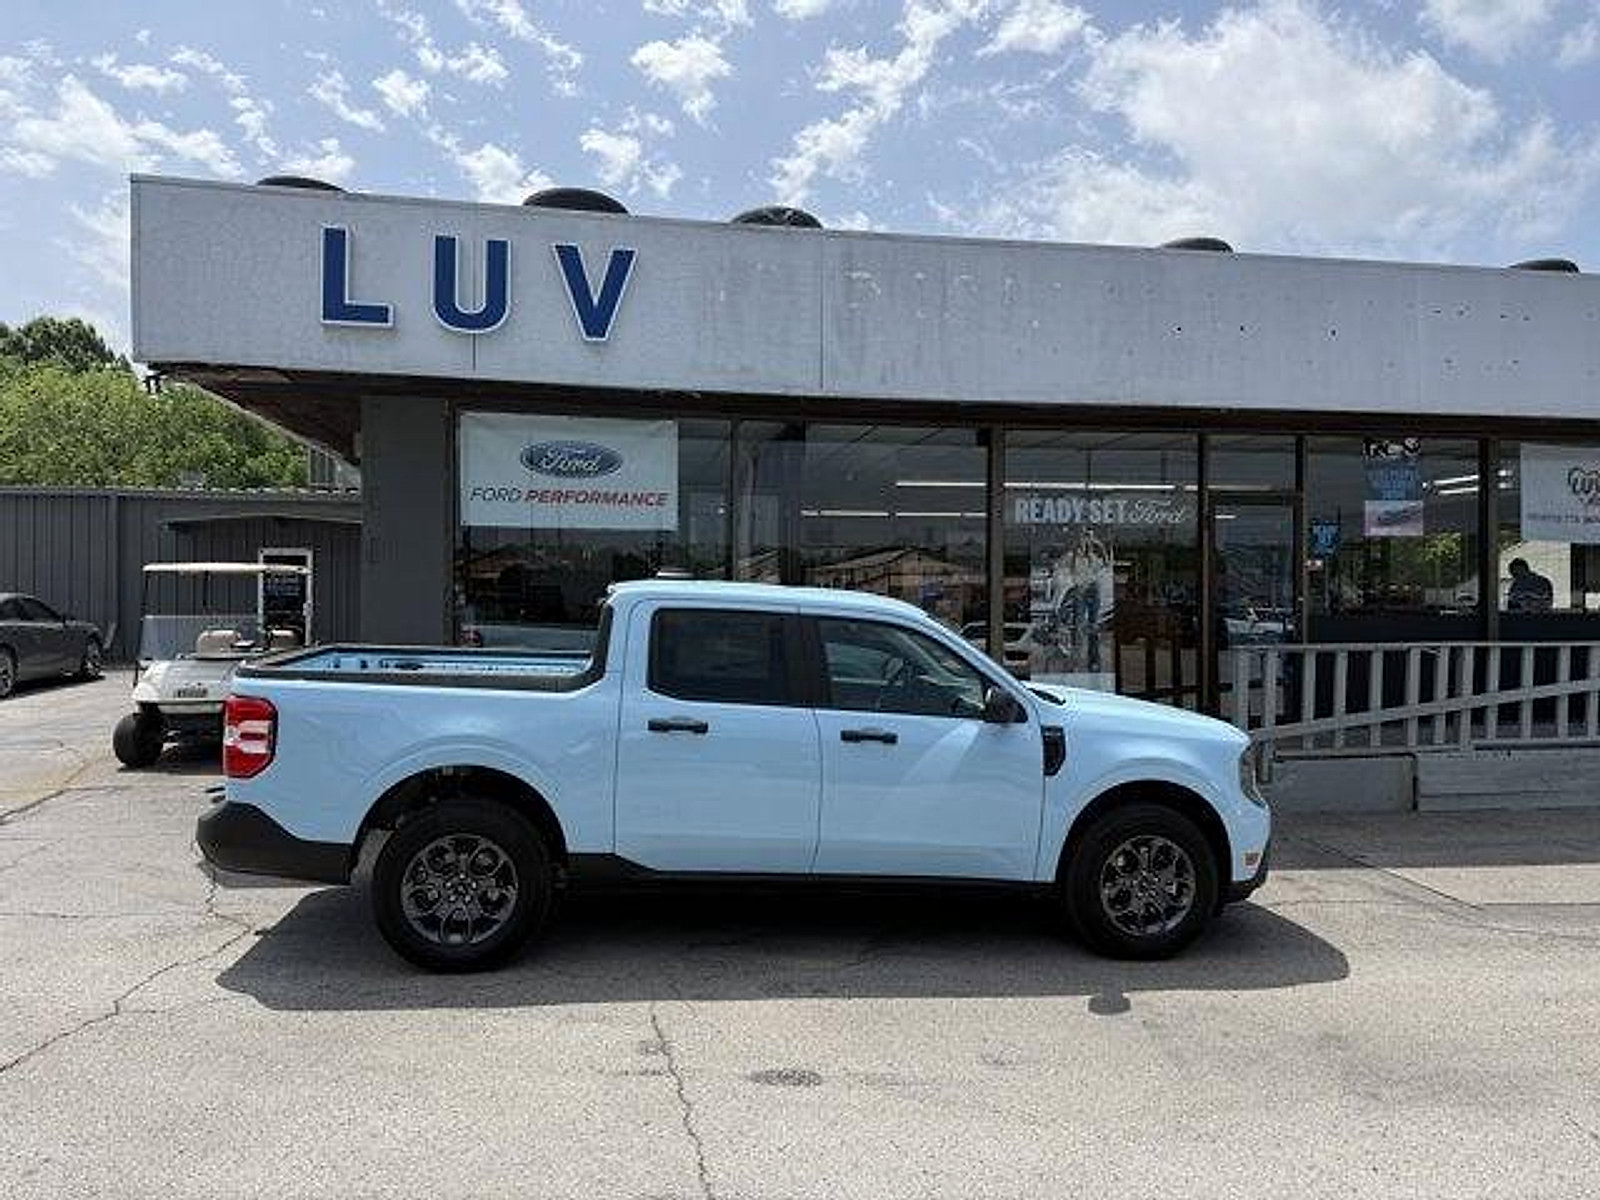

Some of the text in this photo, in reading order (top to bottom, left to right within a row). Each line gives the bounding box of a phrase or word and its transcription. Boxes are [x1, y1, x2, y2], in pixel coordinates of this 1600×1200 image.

[321, 225, 638, 342] LUV
[539, 449, 602, 473] Ford
[470, 486, 669, 508] FORD PERFORMANCE
[1014, 496, 1187, 525] READY SET Ford
